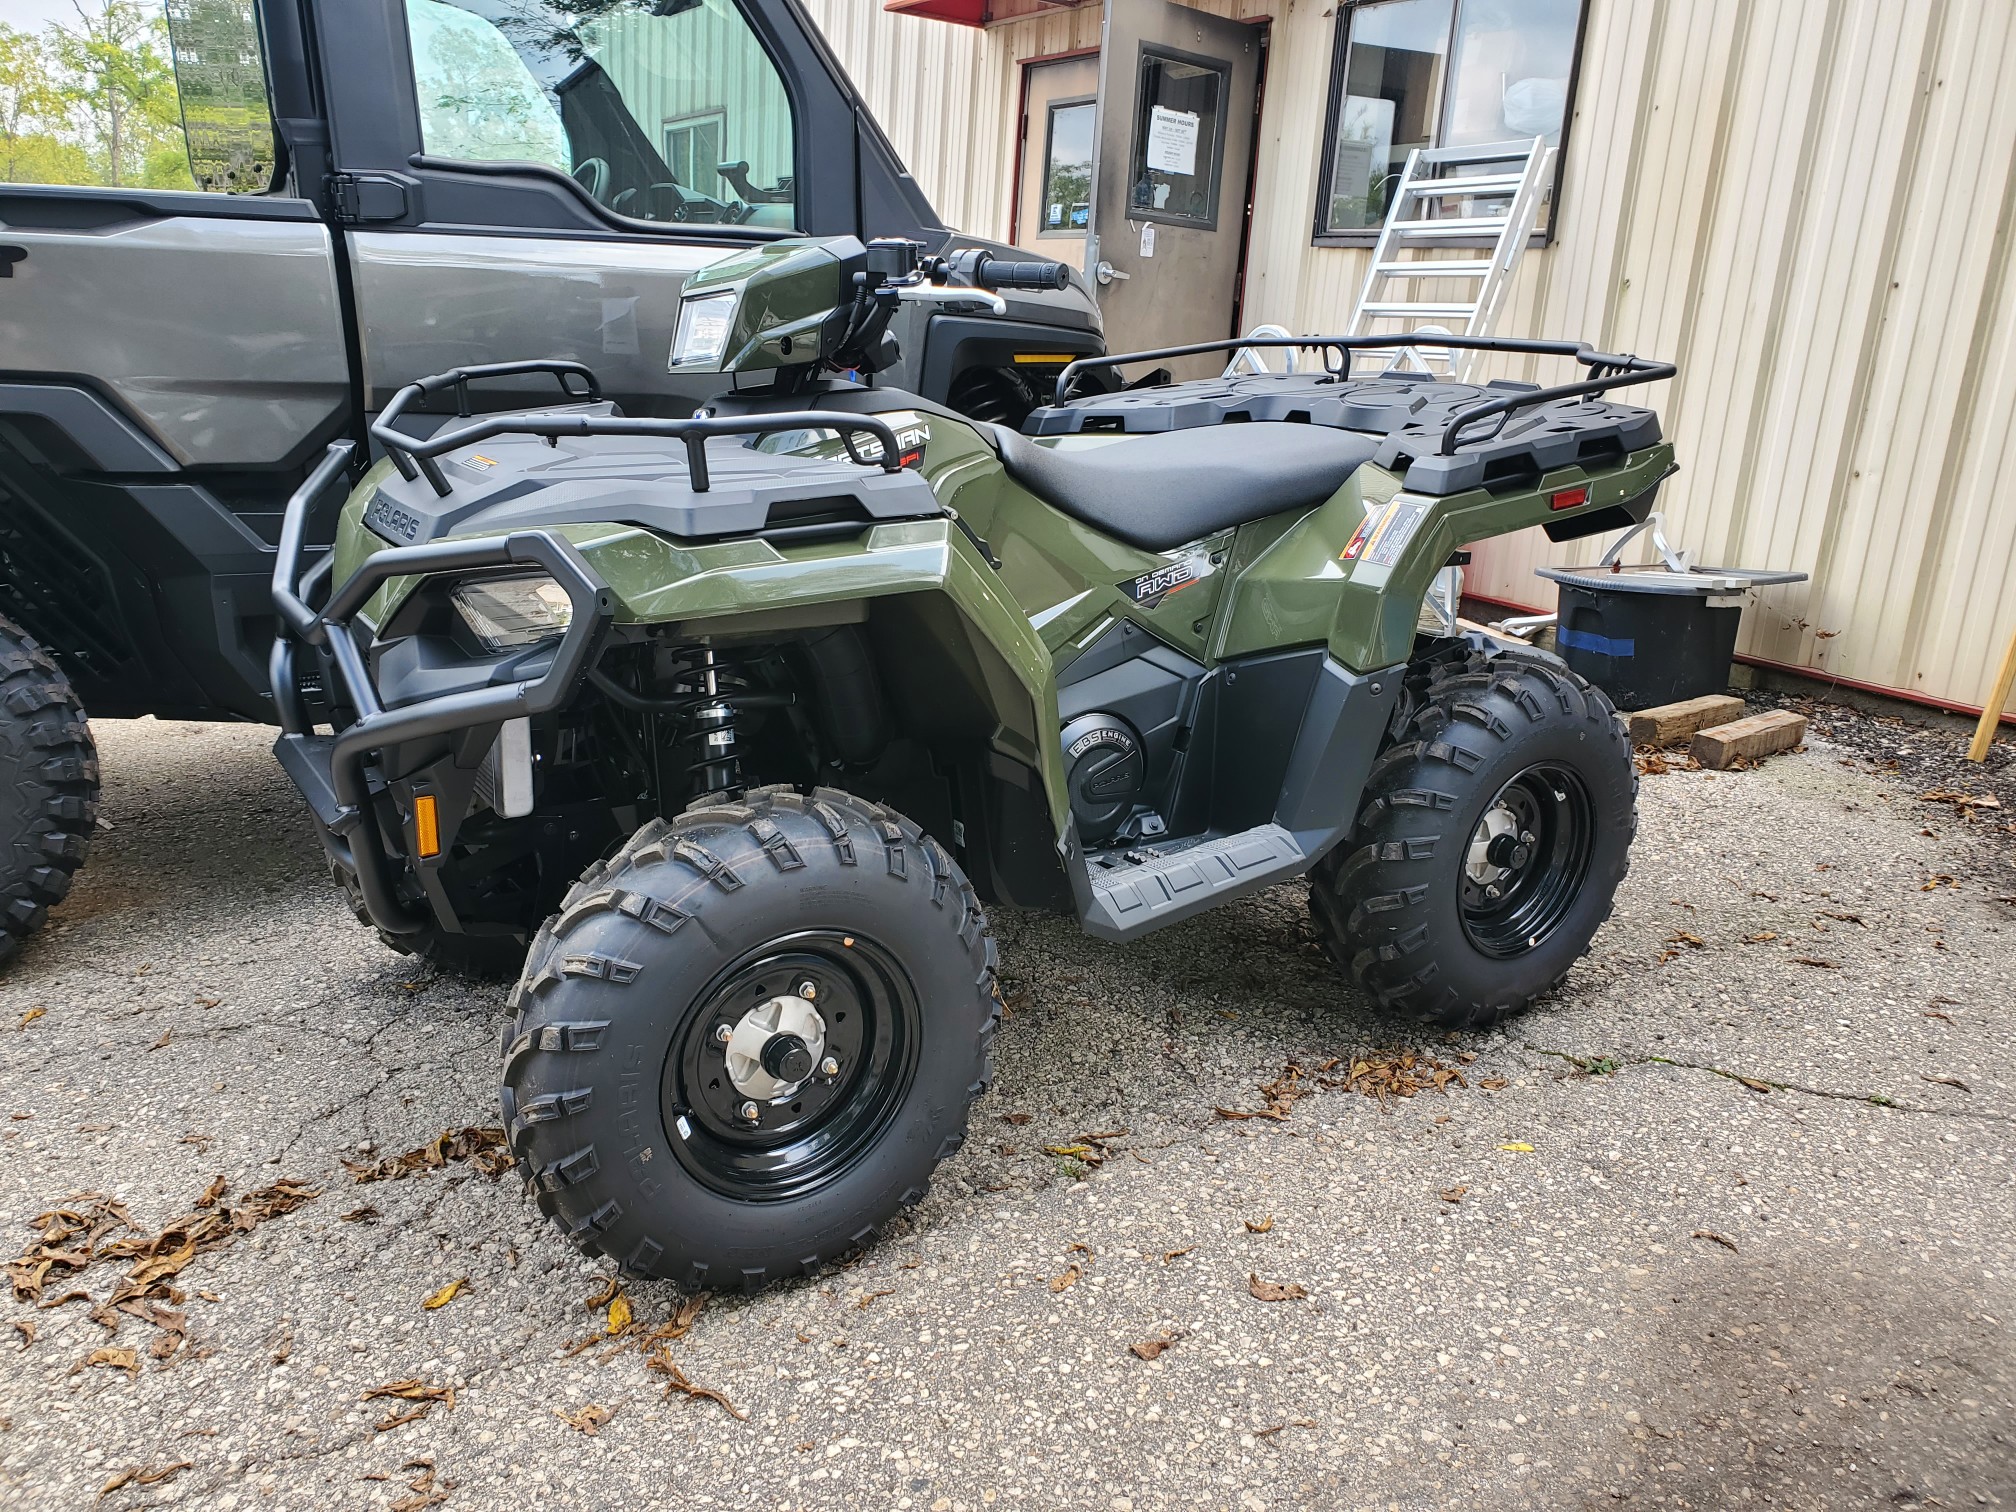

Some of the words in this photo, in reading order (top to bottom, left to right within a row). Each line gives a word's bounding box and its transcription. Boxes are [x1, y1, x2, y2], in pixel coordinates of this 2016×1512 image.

[1156, 114, 1177, 124] SUMMER
[1177, 119, 1195, 128] HOURS
[370, 498, 420, 541] POLARIS
[1135, 575, 1149, 584] ON
[1151, 559, 1193, 578] DEMAND
[1136, 565, 1193, 599] AWD
[1072, 731, 1100, 755] EBS
[1101, 730, 1132, 748] ENGINE
